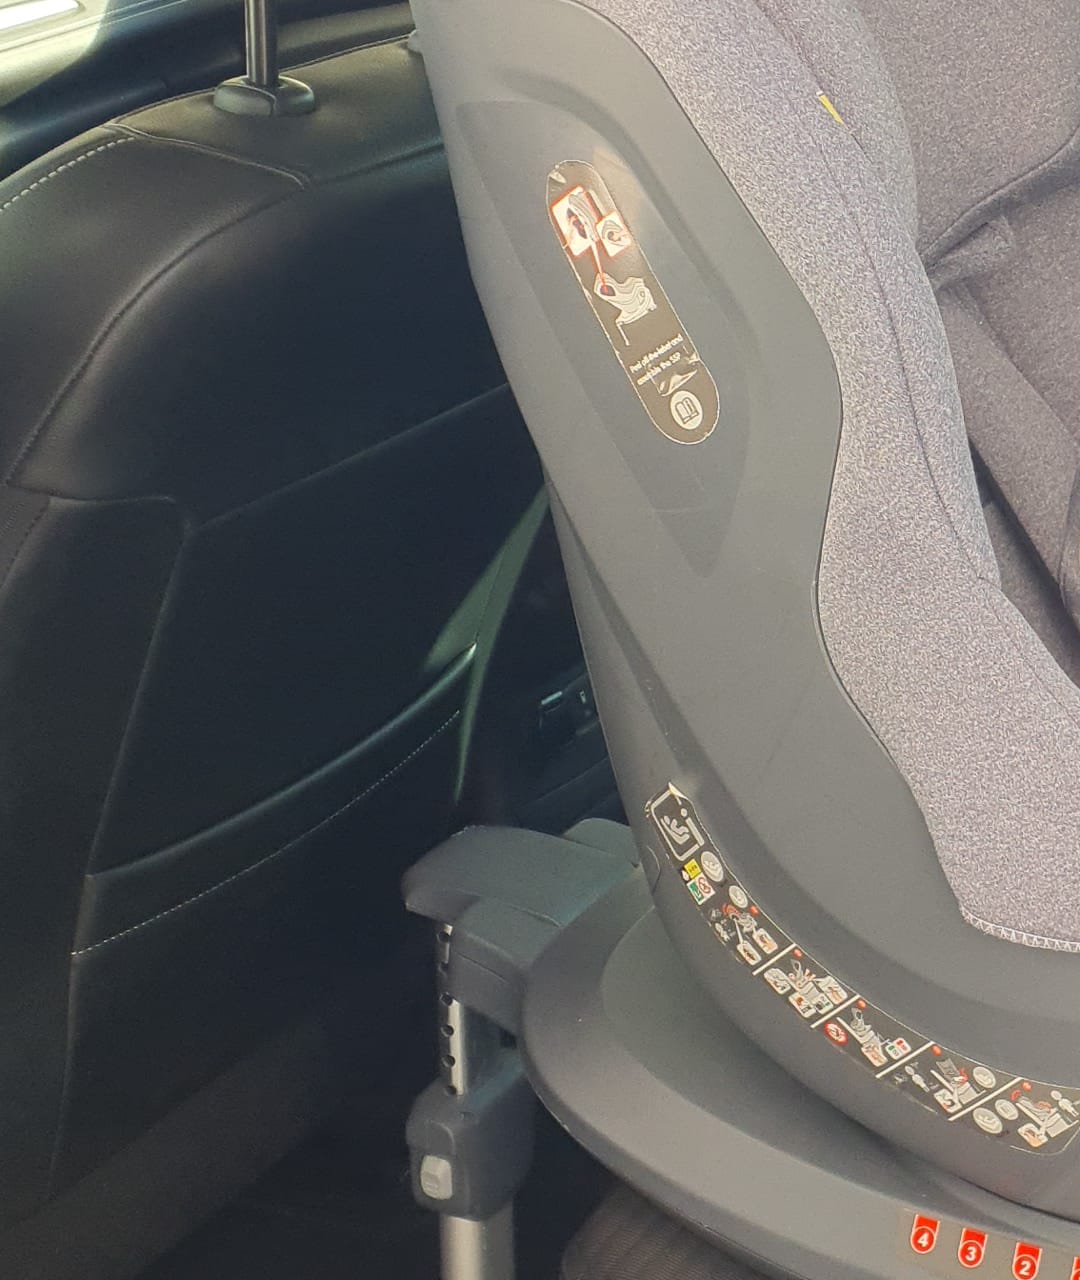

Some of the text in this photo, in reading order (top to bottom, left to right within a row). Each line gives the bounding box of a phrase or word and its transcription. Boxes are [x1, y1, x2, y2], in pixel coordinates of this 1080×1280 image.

[917, 1232, 929, 1248] 4
[965, 1246, 977, 1261] 3
[1019, 1260, 1032, 1276] 2
